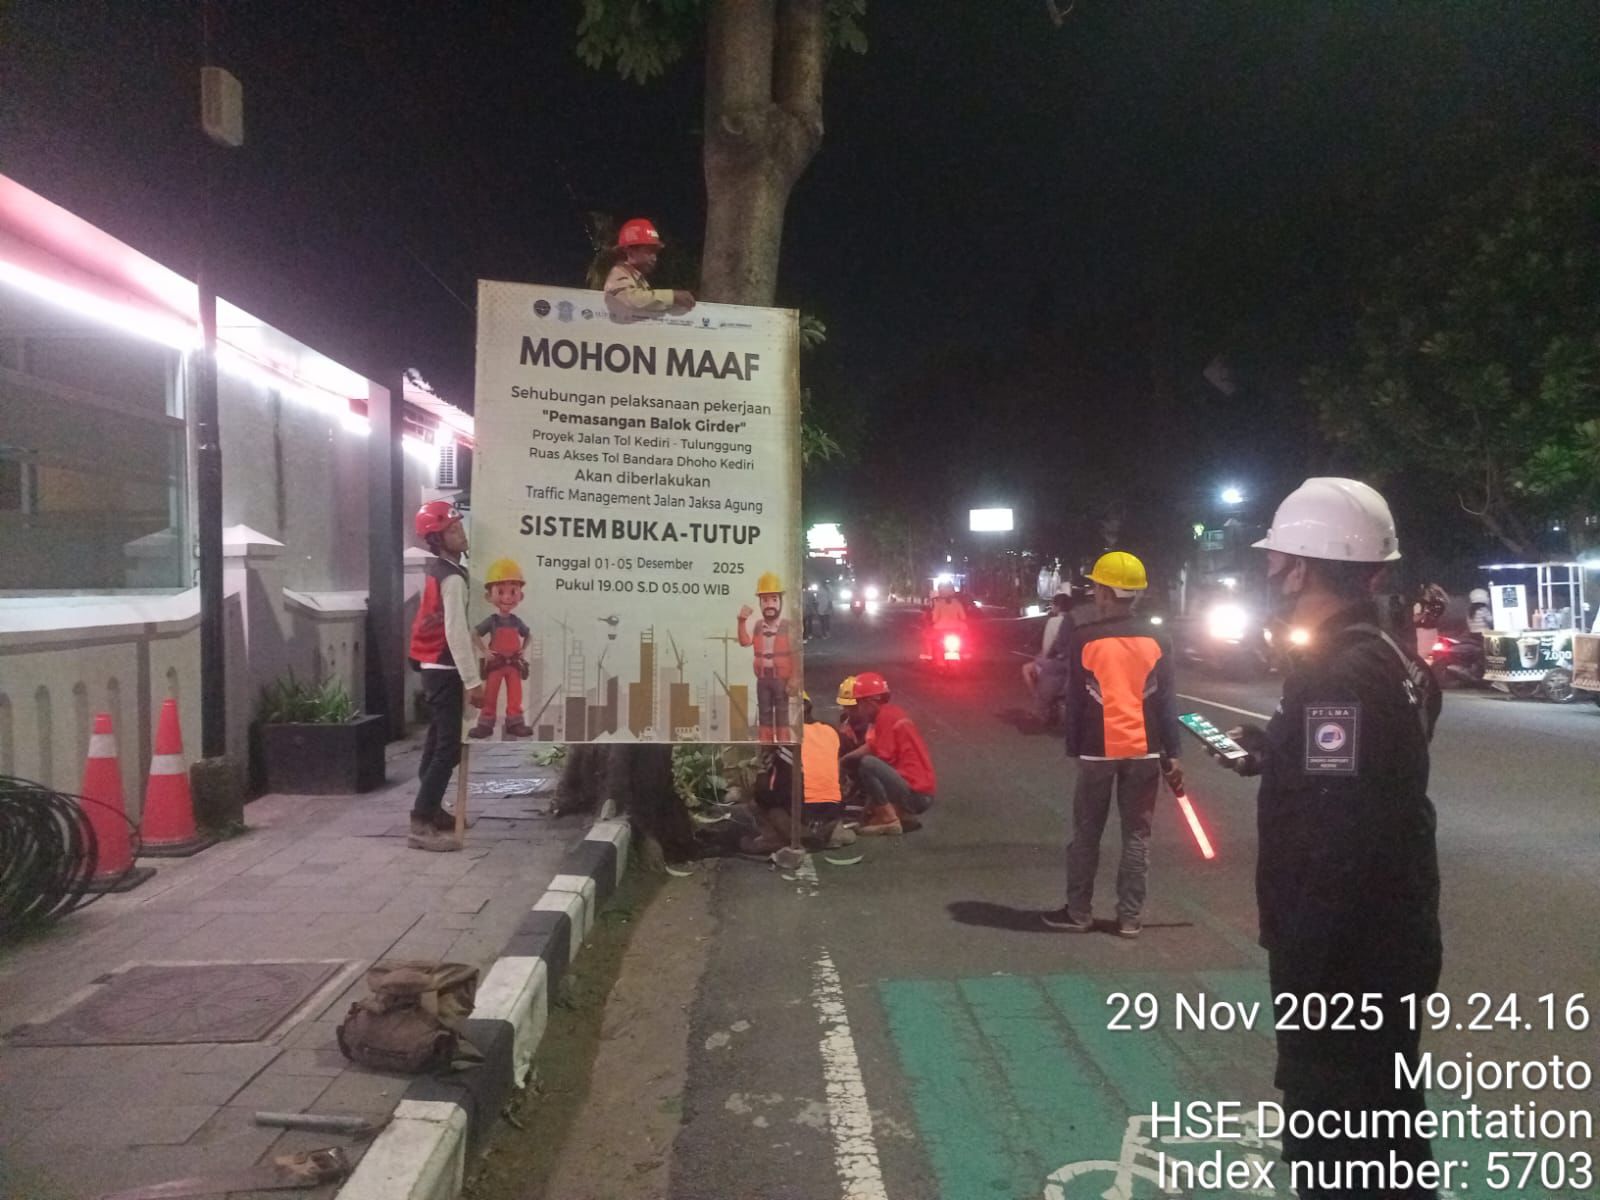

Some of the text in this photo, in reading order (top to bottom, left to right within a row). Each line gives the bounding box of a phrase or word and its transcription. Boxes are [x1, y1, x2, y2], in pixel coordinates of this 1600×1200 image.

[520, 336, 760, 380] MOHON MAAF
[511, 386, 771, 416] Sehubungan pelaksanaan pekerjaan
[543, 410, 746, 433] "Pemasangan Balok Girder"
[533, 429, 574, 444] Proyek
[578, 432, 610, 446] Jalan
[614, 435, 631, 446] Tol
[634, 436, 670, 448] Kediri
[680, 438, 752, 454] Tulunggung
[529, 448, 754, 470] Ruas Akses Tol Bandara Dhoho Kediri
[575, 469, 710, 488] Akan diberlakukan
[526, 485, 763, 514] Traffic Management Jalan Jaksa Agung
[520, 515, 760, 544] SISTEM BUKA-TUTUP
[536, 555, 591, 570] Tanggal
[637, 557, 693, 571] Desember
[713, 562, 744, 574] 2025
[556, 578, 730, 595] Pukul 19.00 S.D 05.00 WIB
